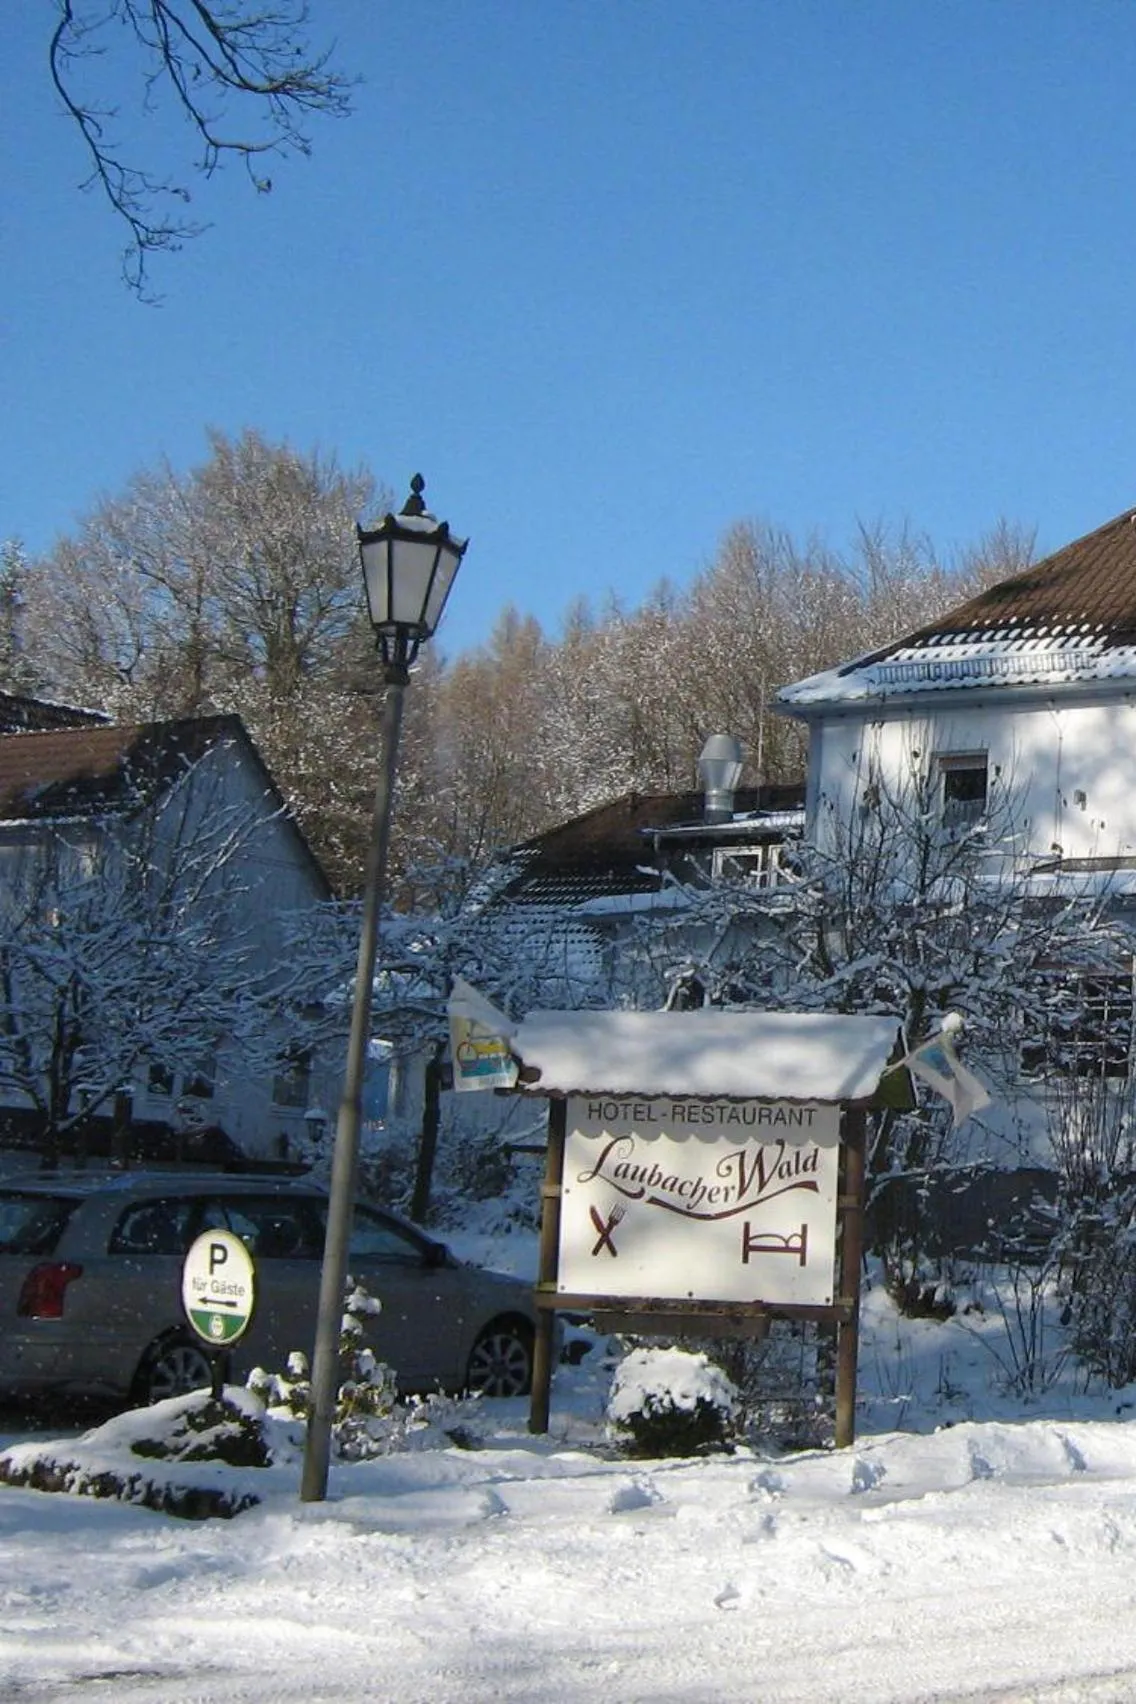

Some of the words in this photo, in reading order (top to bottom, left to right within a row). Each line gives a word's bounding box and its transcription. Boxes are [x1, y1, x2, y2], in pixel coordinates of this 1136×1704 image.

[577, 1136, 736, 1209] Laubacher
[716, 1138, 819, 1201] Wald
[209, 1243, 228, 1275] P
[192, 1277, 207, 1292] für
[211, 1280, 246, 1297] Gäste
